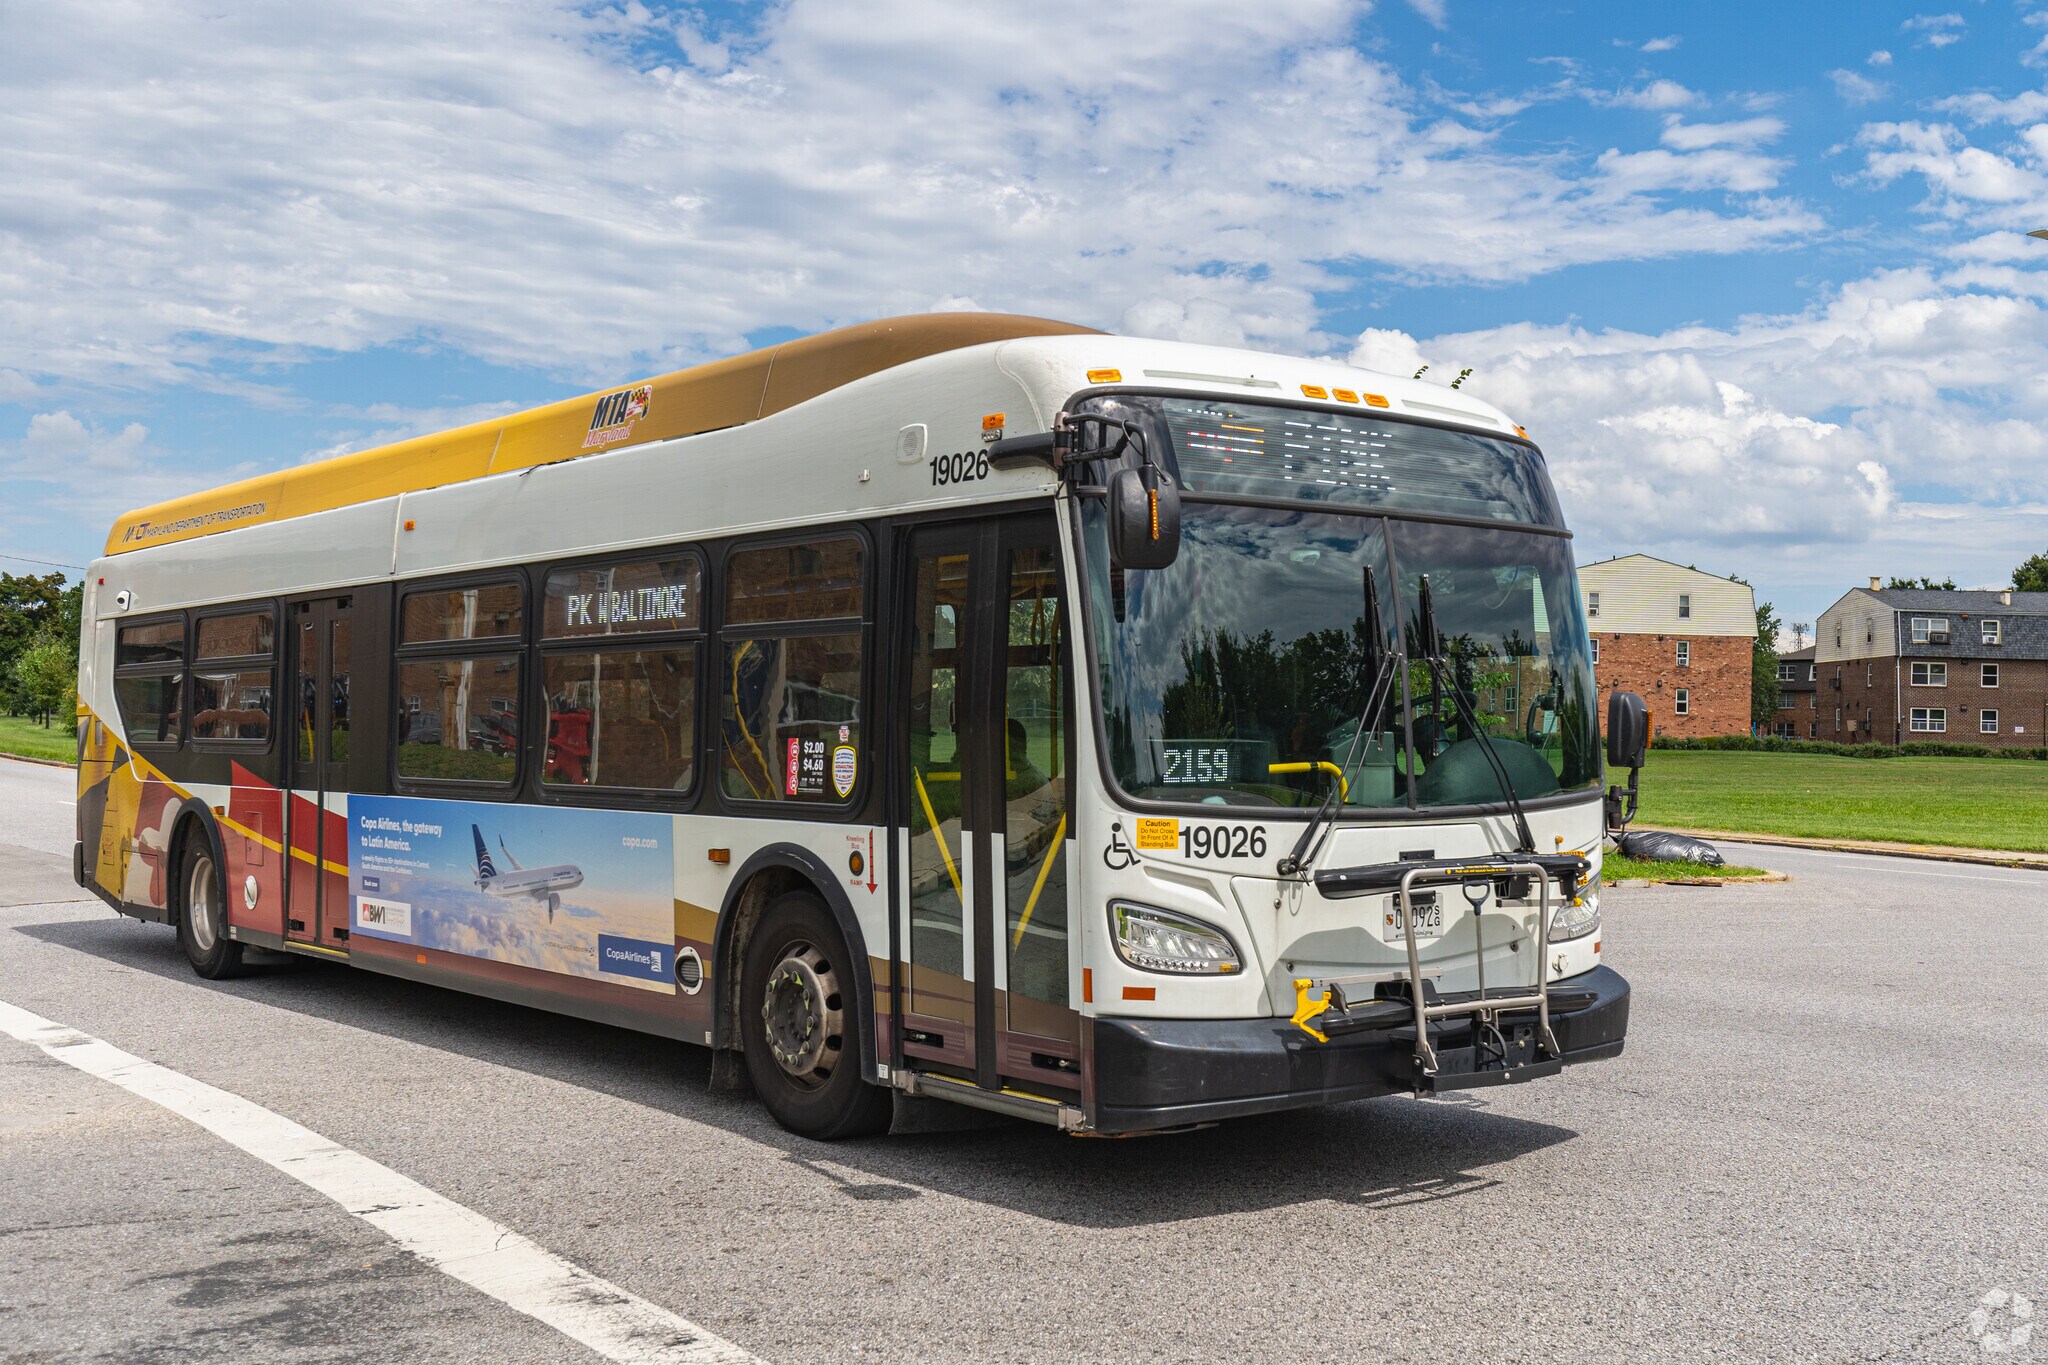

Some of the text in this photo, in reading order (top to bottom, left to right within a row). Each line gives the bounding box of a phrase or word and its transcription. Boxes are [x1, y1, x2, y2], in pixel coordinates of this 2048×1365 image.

[590, 389, 632, 431] MTA
[582, 420, 635, 448] Maryland
[930, 449, 990, 486] 19026
[217, 502, 266, 523] TRANSPORTATION
[568, 593, 594, 626] PK
[611, 584, 687, 623] BALTIMORE
[804, 741, 824, 754] $2.00
[803, 758, 823, 771] $4.60
[1163, 749, 1228, 783] 2159
[361, 816, 442, 838] Copa Airlines, the gateway
[361, 835, 411, 851] to Latin America.
[622, 837, 658, 849] copa.com
[1179, 826, 1267, 859] 19026
[1395, 906, 1433, 930] 0092
[606, 947, 651, 965] CopaAirlines
